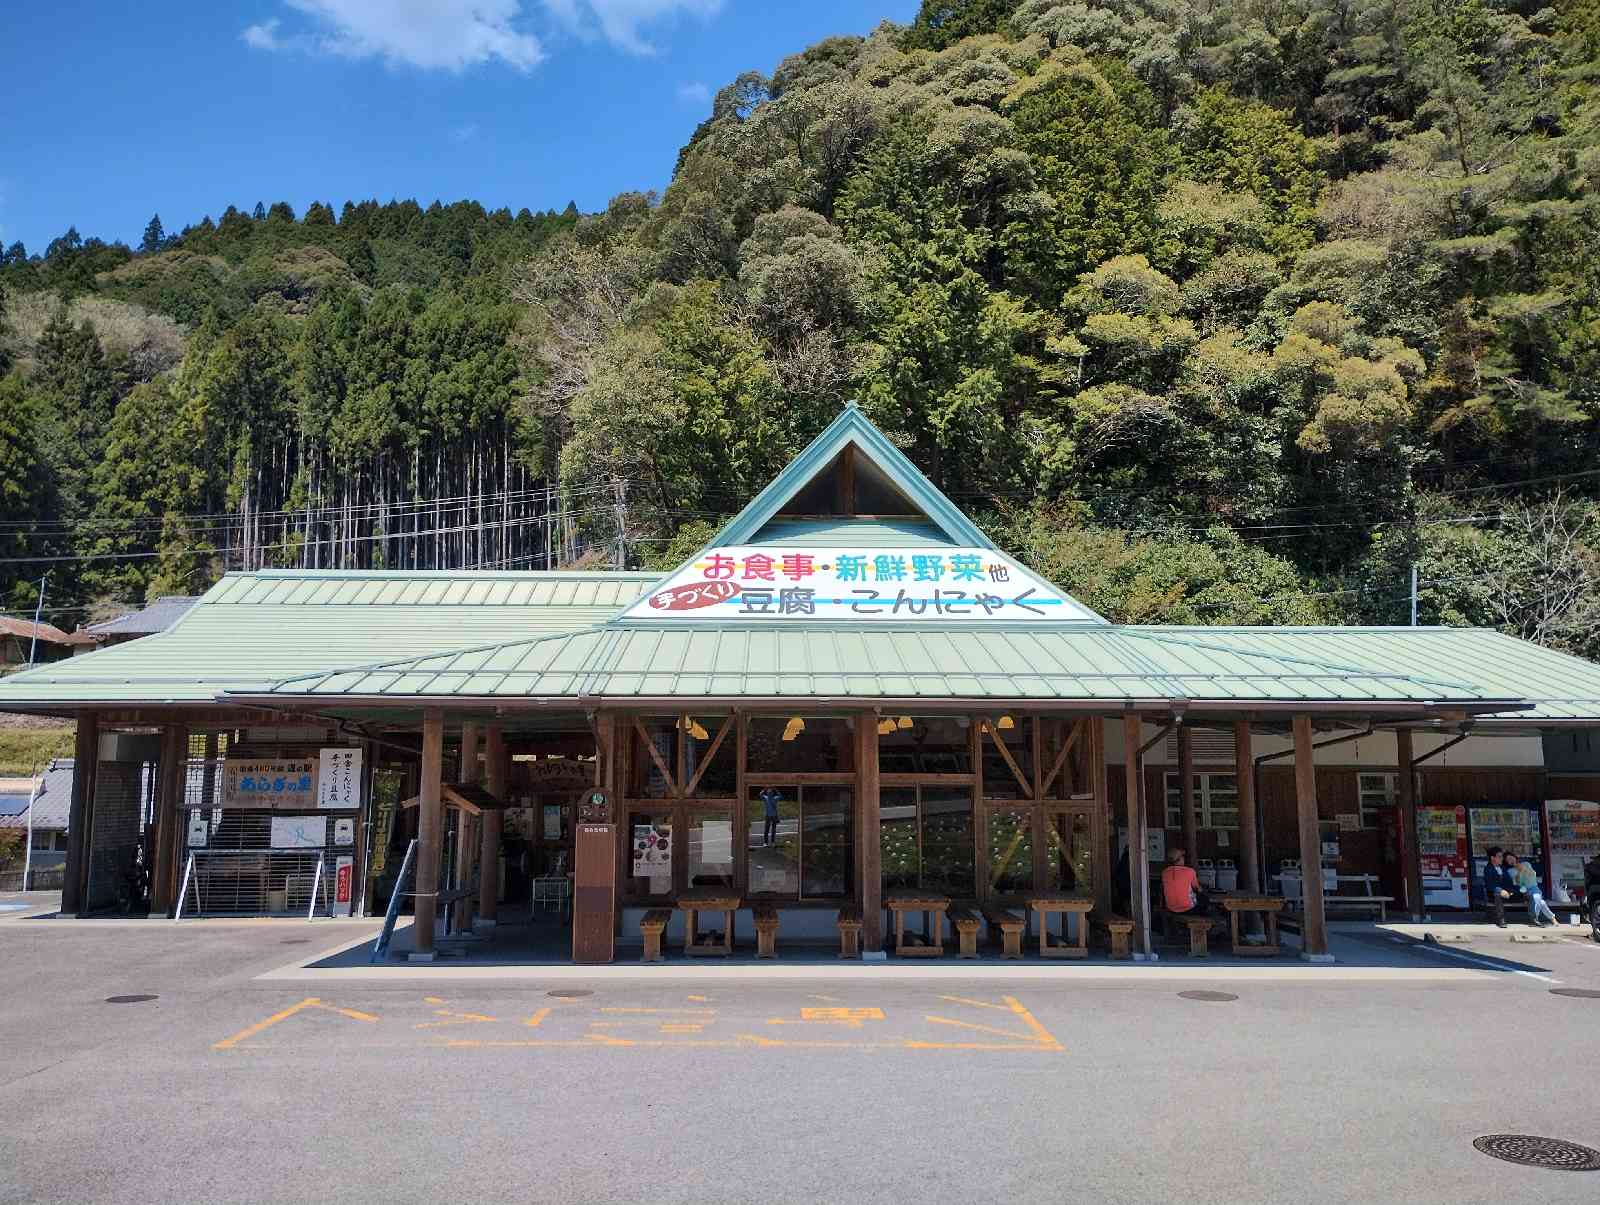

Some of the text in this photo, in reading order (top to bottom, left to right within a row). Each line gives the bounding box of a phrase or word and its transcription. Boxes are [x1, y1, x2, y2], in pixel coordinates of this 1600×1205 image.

[703, 553, 1010, 583] お食事・新鮮野菜他
[657, 581, 735, 609] 手づくり
[738, 586, 1046, 615] 豆腐・こんにゃく
